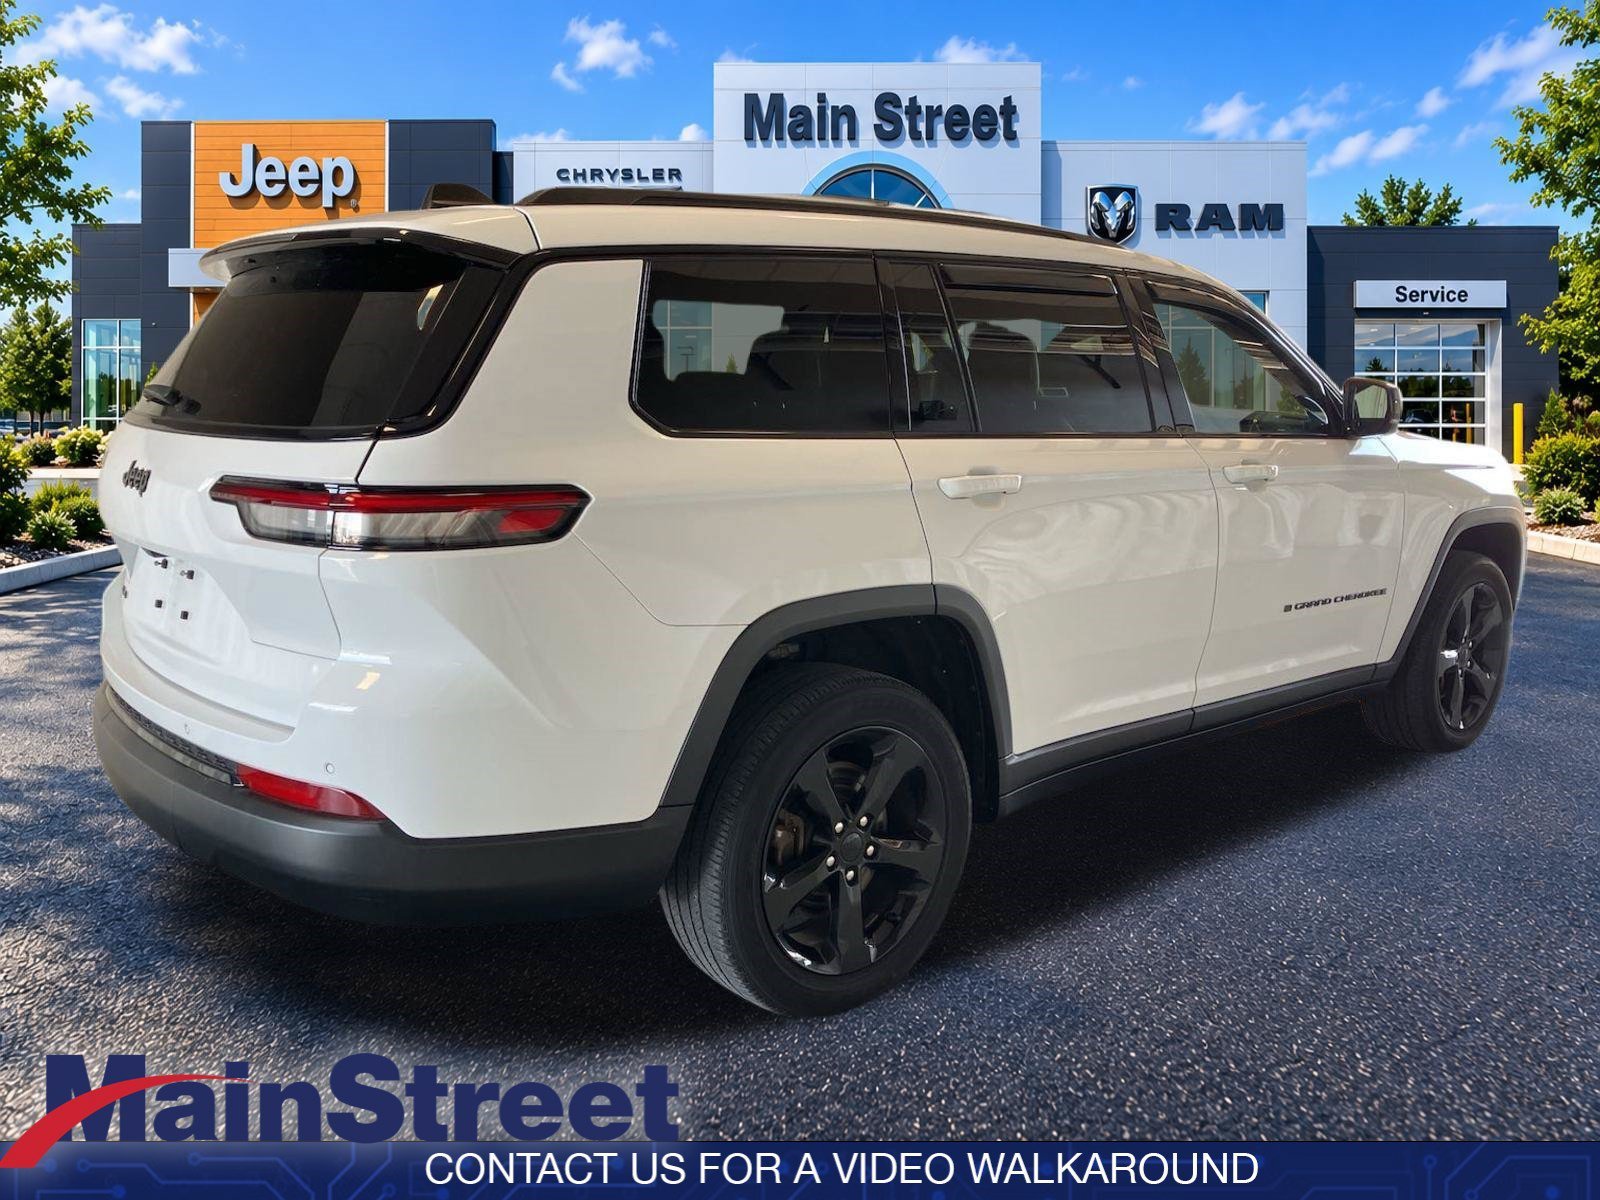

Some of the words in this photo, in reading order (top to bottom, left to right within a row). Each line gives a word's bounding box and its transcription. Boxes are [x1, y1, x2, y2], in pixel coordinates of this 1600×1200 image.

[743, 92, 857, 141] Main
[873, 91, 1018, 142] Street
[218, 143, 355, 208] Jeep
[556, 168, 682, 182] CHRYSLER
[1155, 203, 1284, 232] RAM
[1395, 285, 1469, 303] Service
[122, 459, 152, 498] Jeep
[1294, 598, 1332, 610] GRAND
[1334, 588, 1387, 602] CHEROKEE
